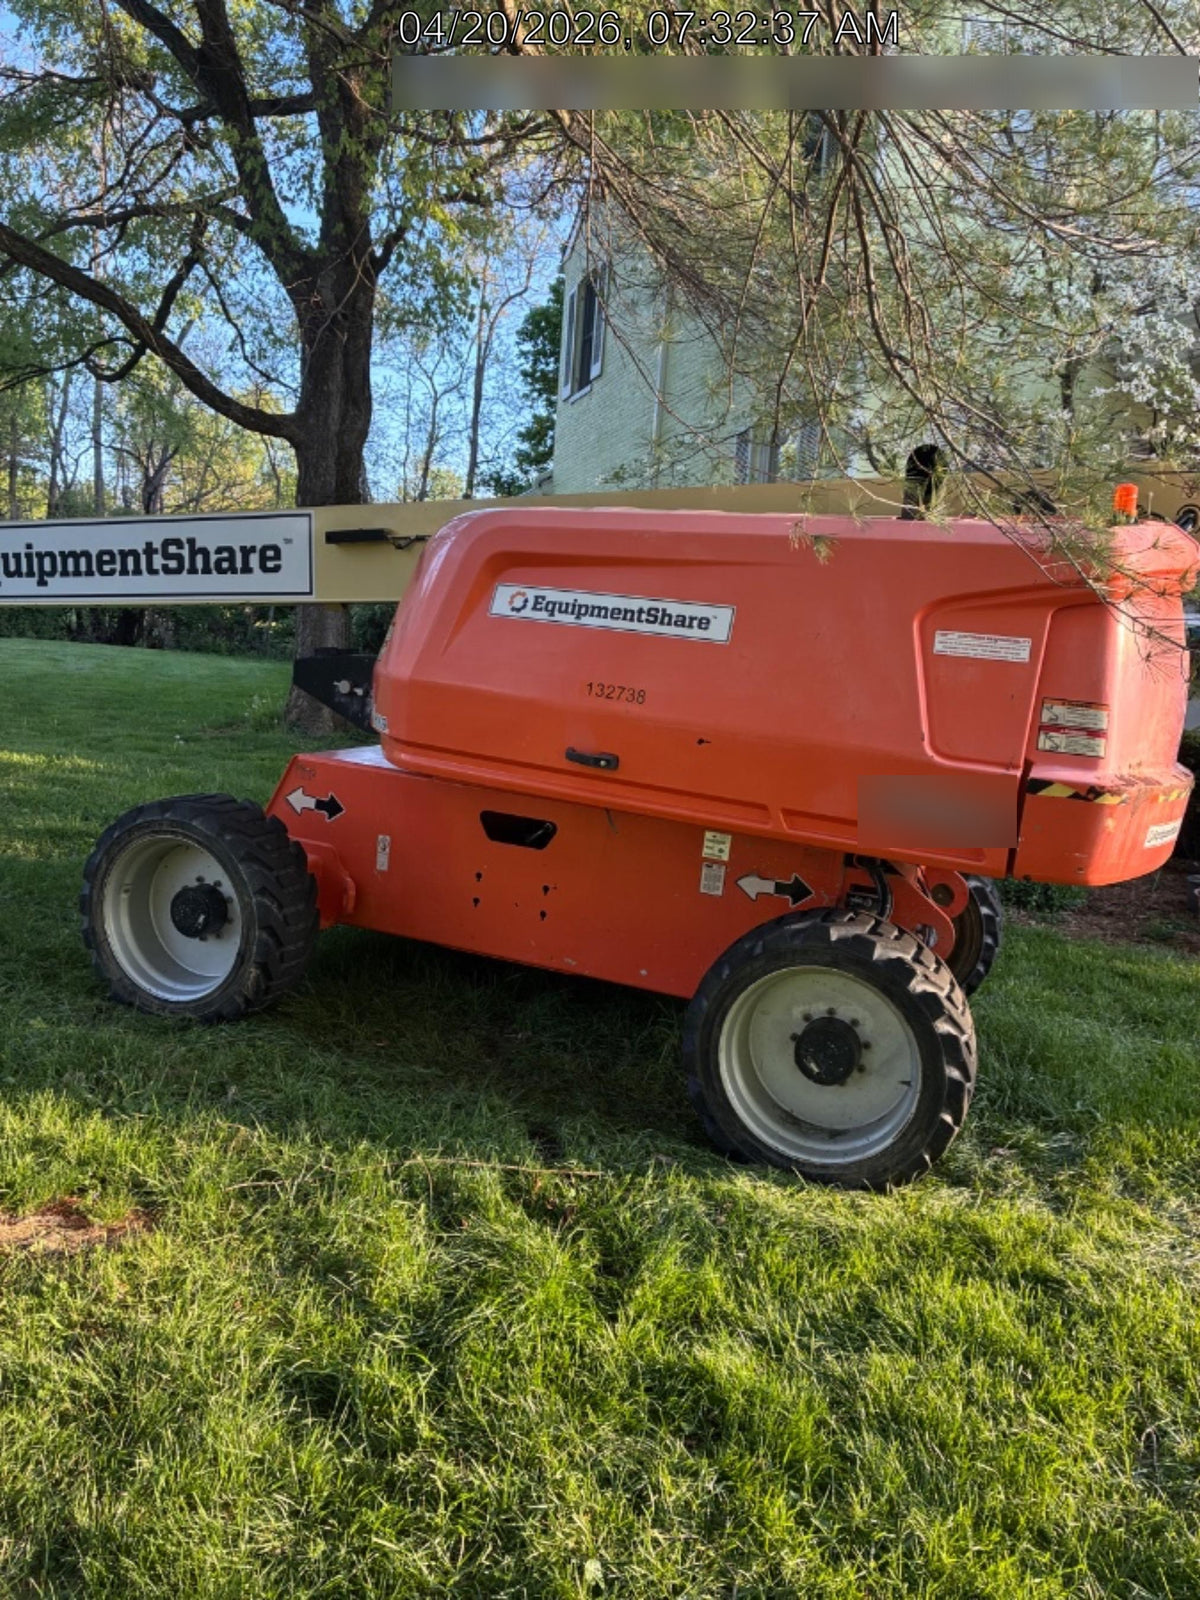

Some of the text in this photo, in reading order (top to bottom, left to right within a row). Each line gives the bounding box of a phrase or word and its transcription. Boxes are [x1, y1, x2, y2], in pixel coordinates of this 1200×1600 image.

[0, 537, 282, 587] uipmentShare
[531, 595, 711, 630] EquipmentShare
[586, 681, 646, 705] 132738
